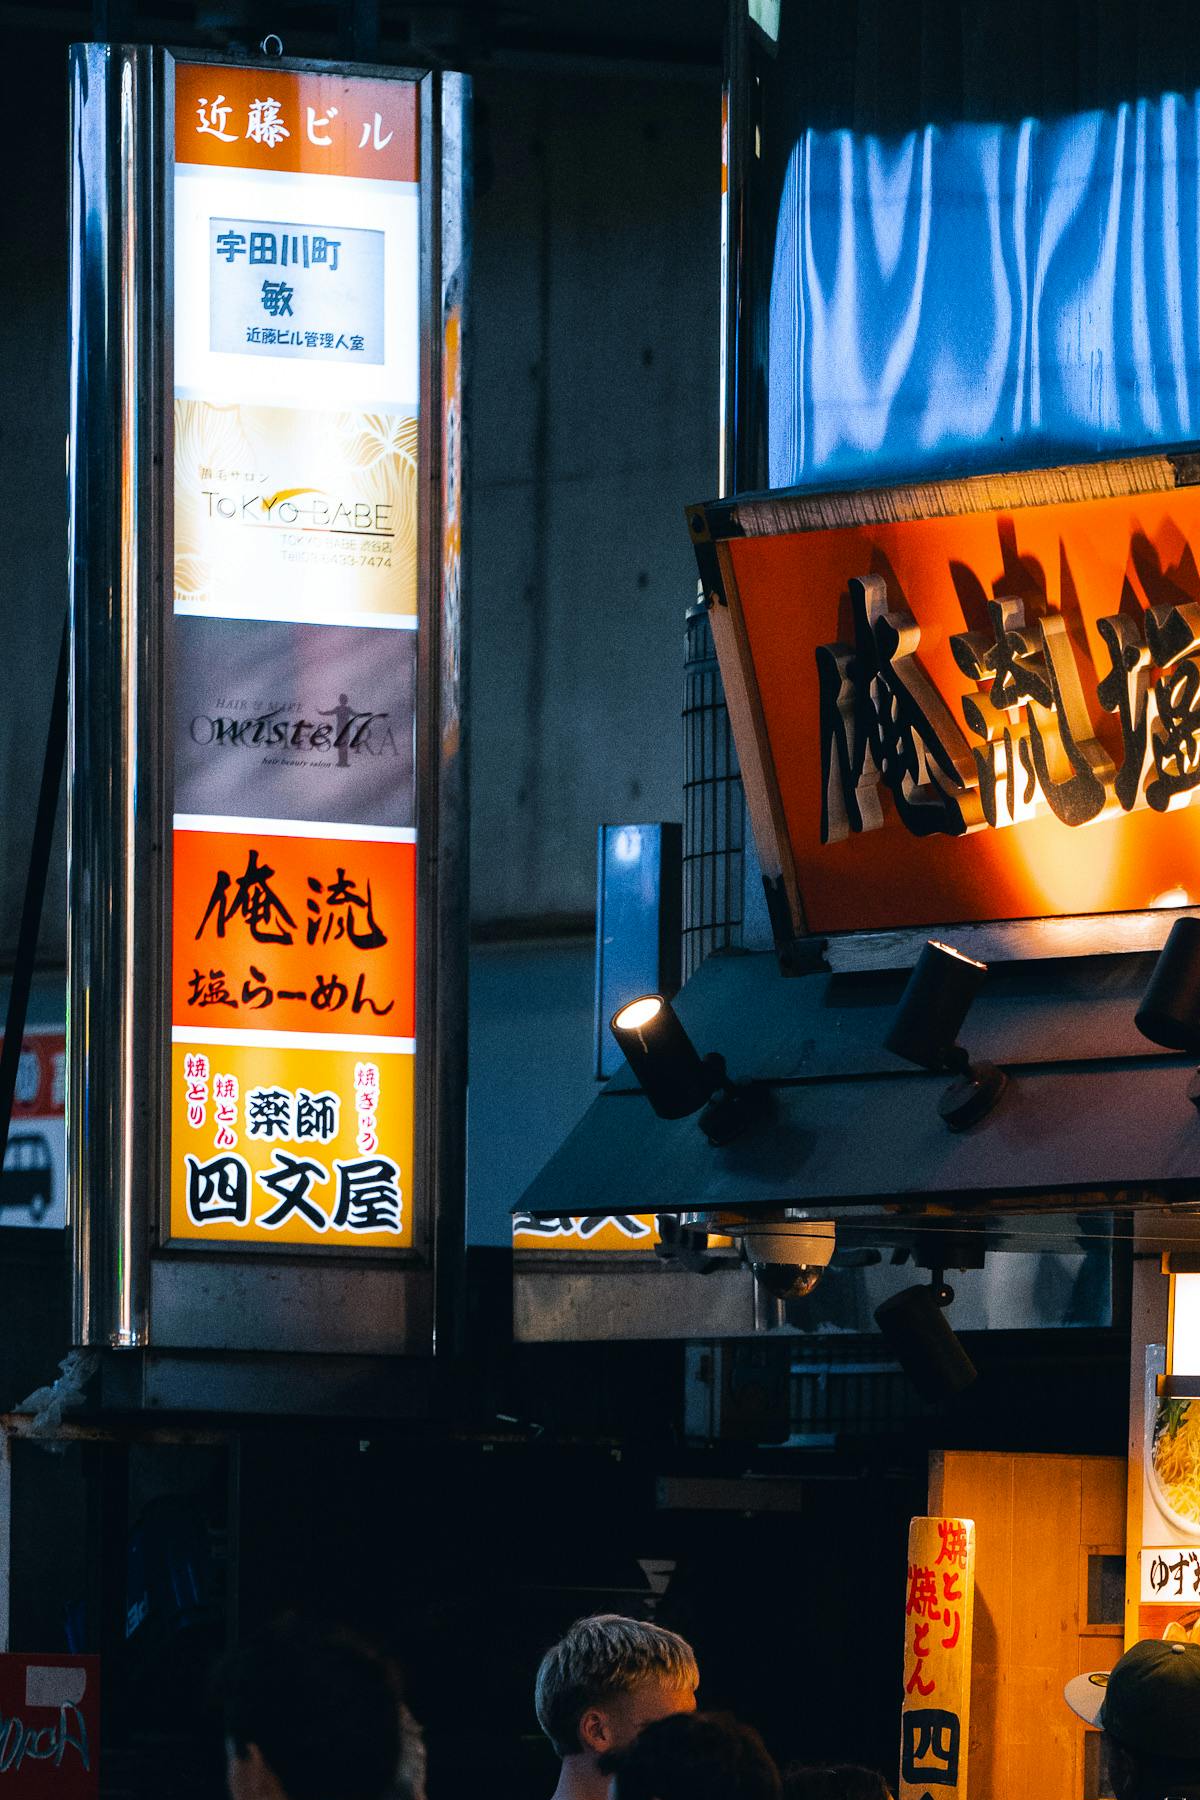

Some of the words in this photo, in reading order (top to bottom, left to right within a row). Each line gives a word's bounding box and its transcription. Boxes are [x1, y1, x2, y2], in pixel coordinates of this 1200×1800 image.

[195, 94, 394, 151] 近藤ビル
[216, 229, 342, 271] 宇田川町
[260, 279, 294, 318] 敏
[246, 326, 365, 352] 近藤ビル管理人室
[312, 500, 393, 530] BABE
[194, 848, 389, 950] 俺流
[187, 964, 396, 1017] 塩らーめん
[187, 1057, 208, 1126] 焼とり
[215, 1077, 237, 1147] 焼とん
[249, 1090, 337, 1140] 薬師
[356, 1066, 377, 1152] 焼ぎゅう
[187, 1153, 400, 1231] 四文屋
[934, 1520, 968, 1649] 焼とり
[905, 1563, 941, 1697] 焼とん
